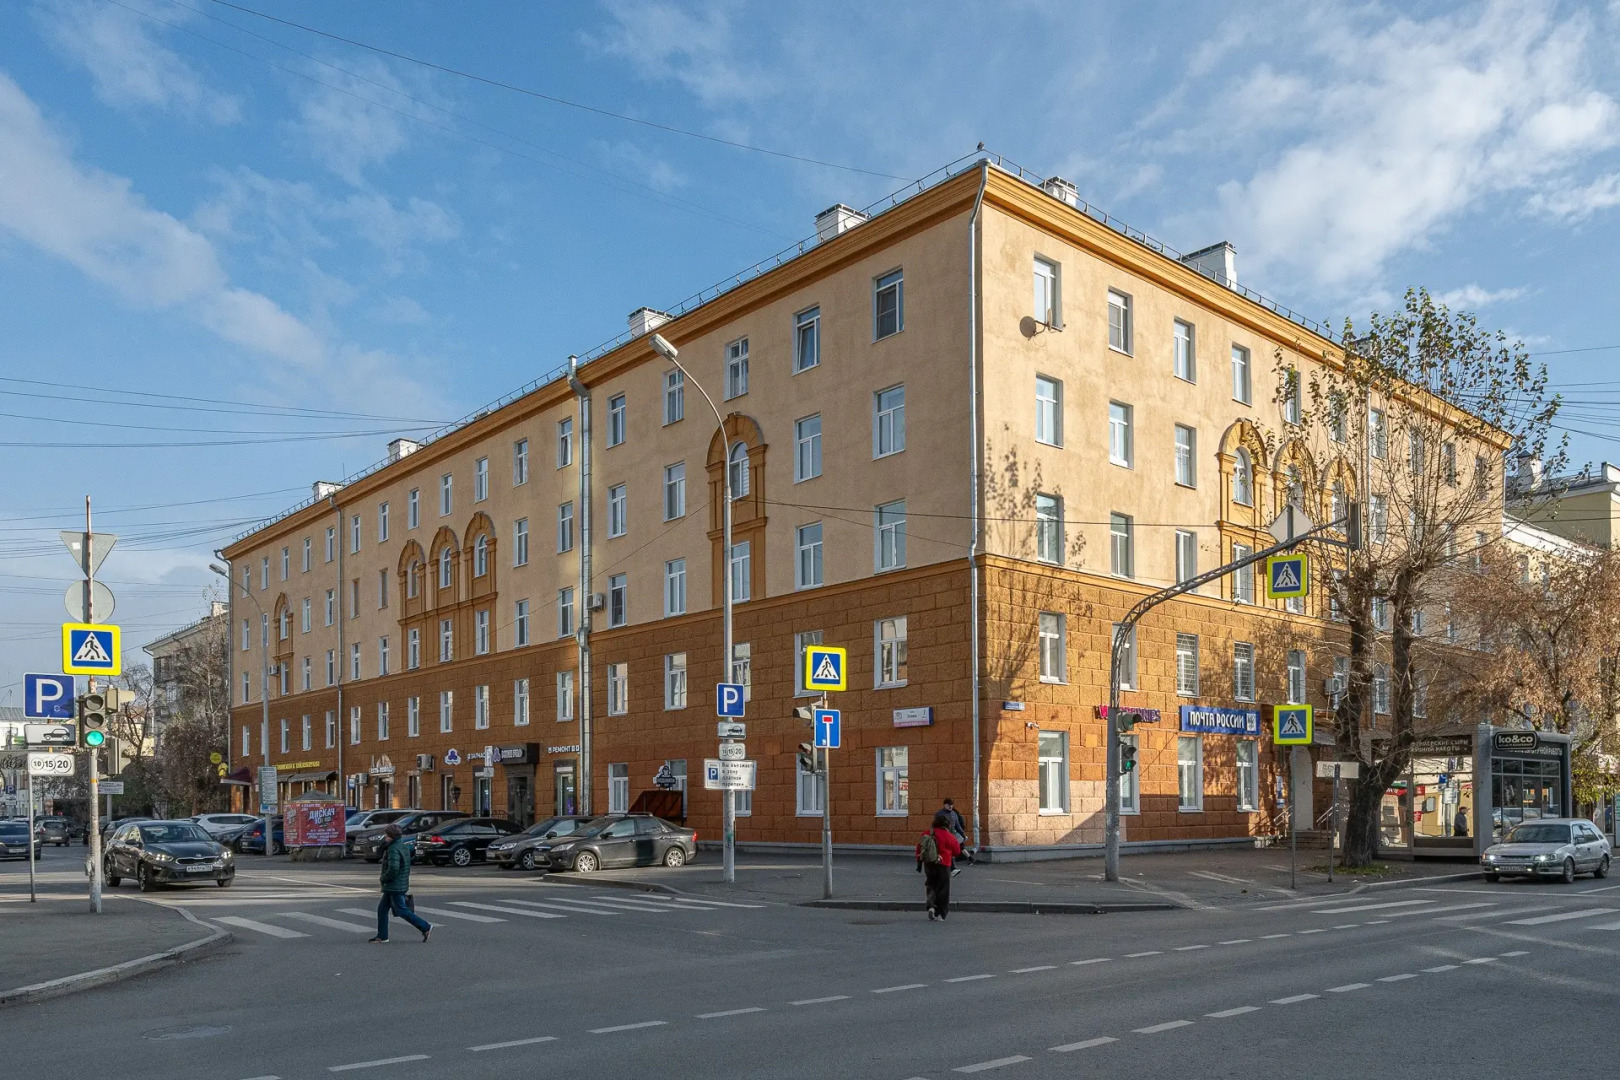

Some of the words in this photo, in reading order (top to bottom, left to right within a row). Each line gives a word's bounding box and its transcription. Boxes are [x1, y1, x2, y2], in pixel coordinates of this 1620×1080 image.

[36, 678, 64, 714] P
[724, 688, 738, 712] P
[1190, 712, 1214, 726] ПОЧТА
[1216, 714, 1244, 728] РОССИИ
[1498, 735, 1534, 744] ko&co
[57, 760, 68, 768] 20
[710, 769, 716, 778] P
[309, 808, 334, 820] ДИСКАЧ
